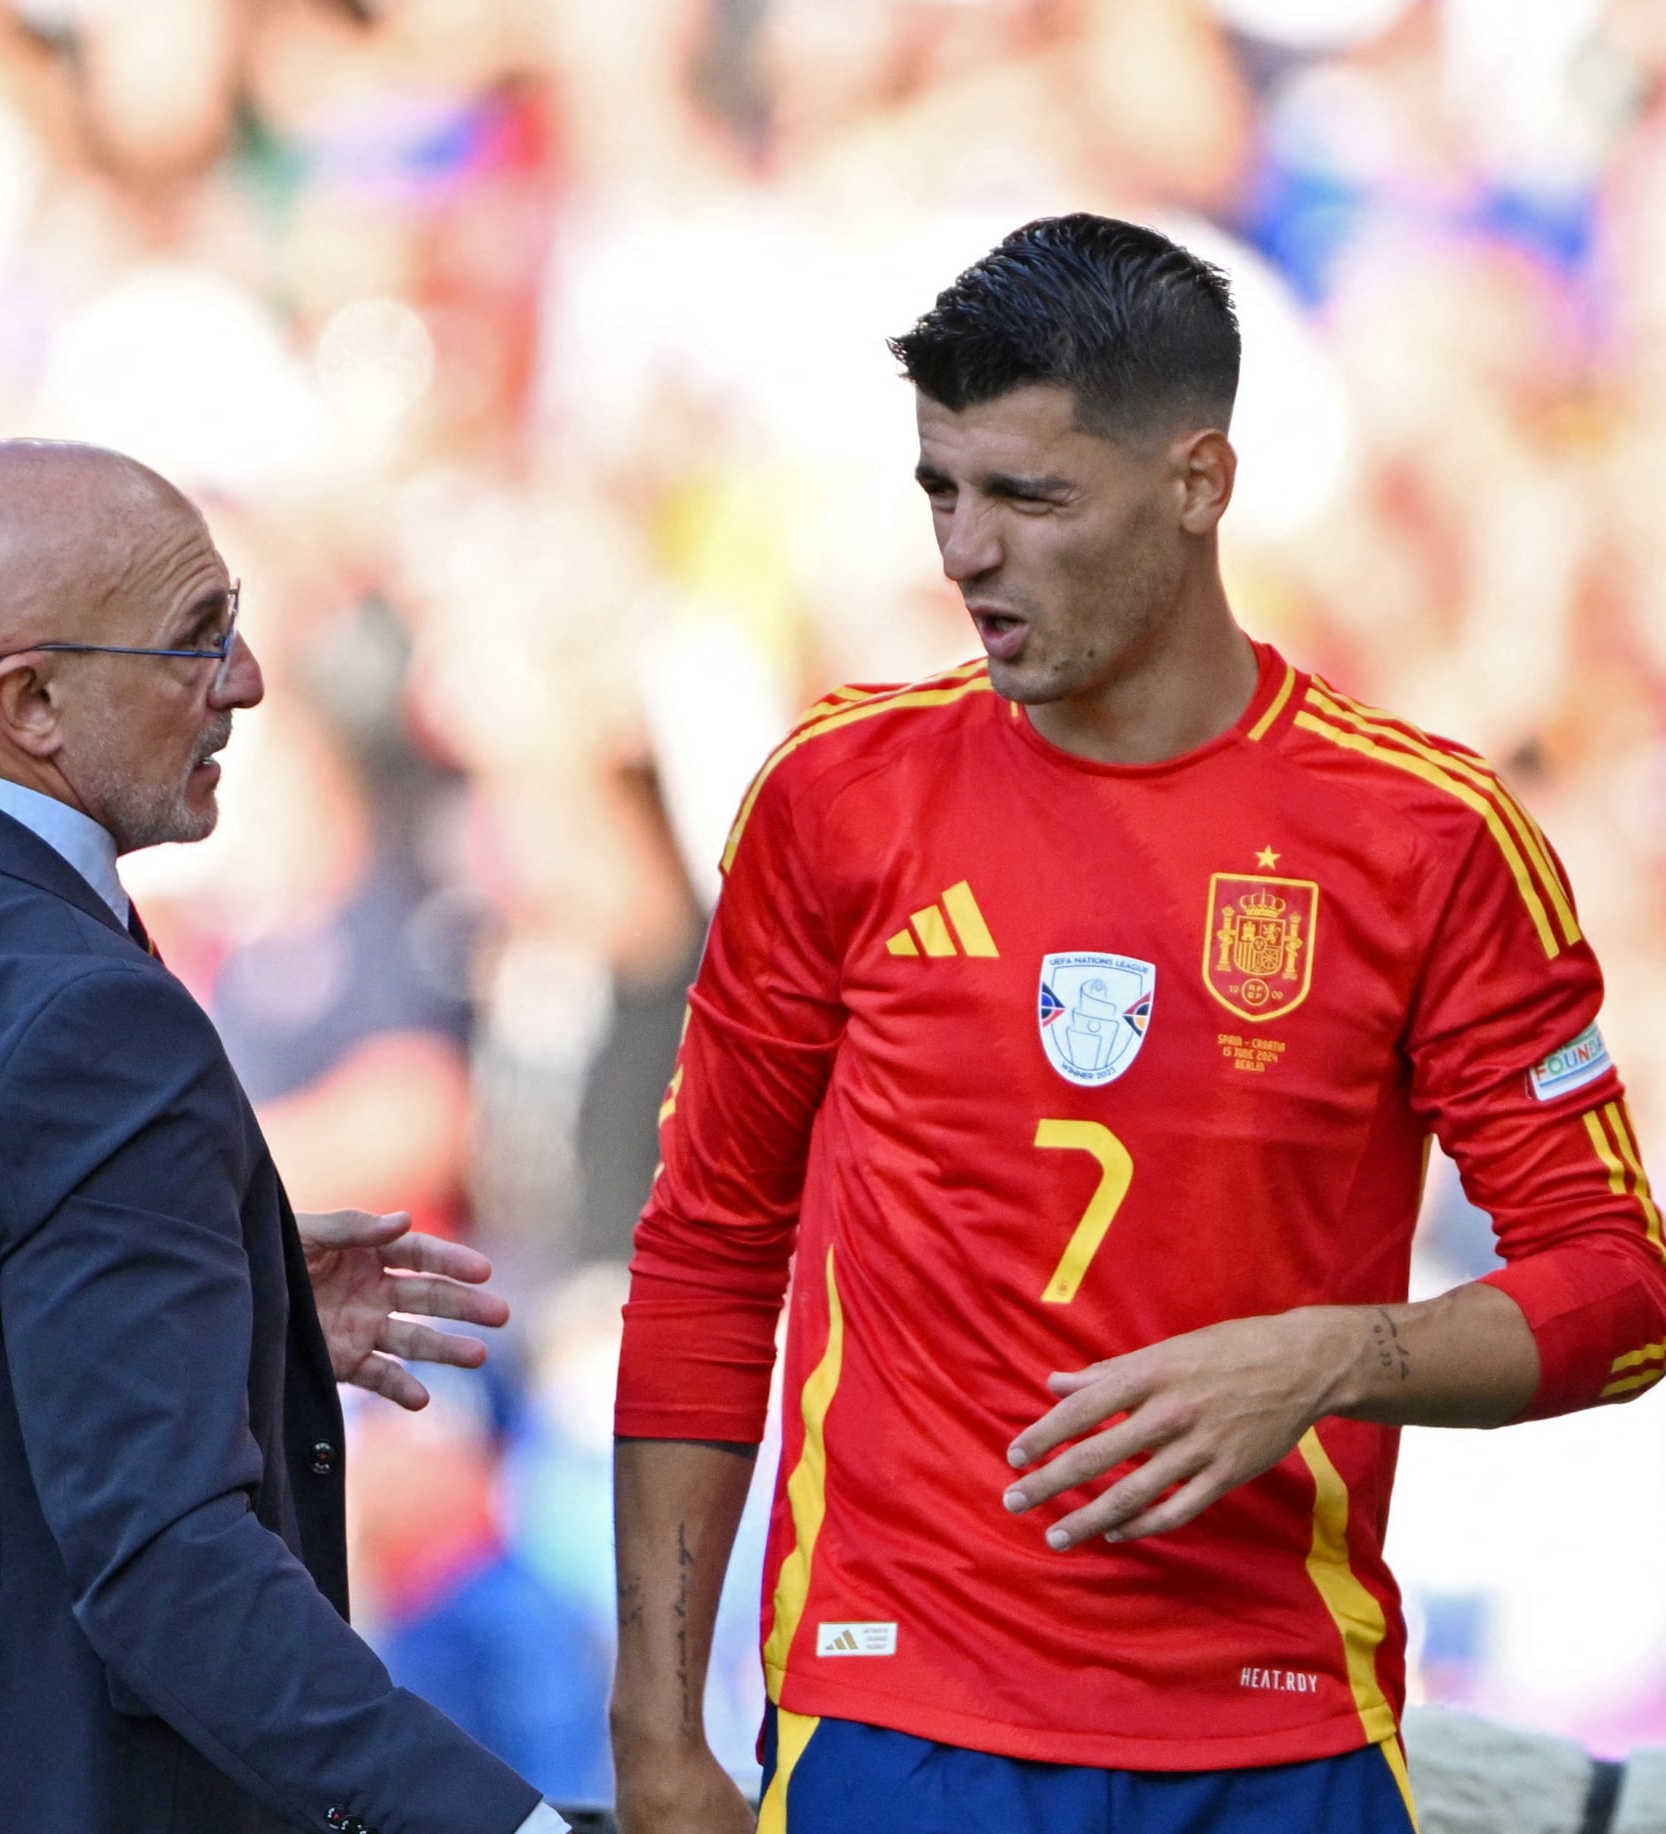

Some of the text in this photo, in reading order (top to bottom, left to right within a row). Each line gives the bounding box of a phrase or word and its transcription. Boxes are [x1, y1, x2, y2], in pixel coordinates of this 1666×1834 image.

[1049, 956, 1149, 974] UEFA NATIONS LEAGUE
[1217, 1033, 1243, 1047] SPAIN
[1252, 1038, 1286, 1052] CROATIA
[1235, 1058, 1265, 1072] BERLIN
[1256, 1049, 1278, 1063] 2024
[1062, 1062, 1094, 1079] WINNER
[1034, 1118, 1133, 1304] 7
[1240, 1667, 1317, 1693] HEAT.RDY
